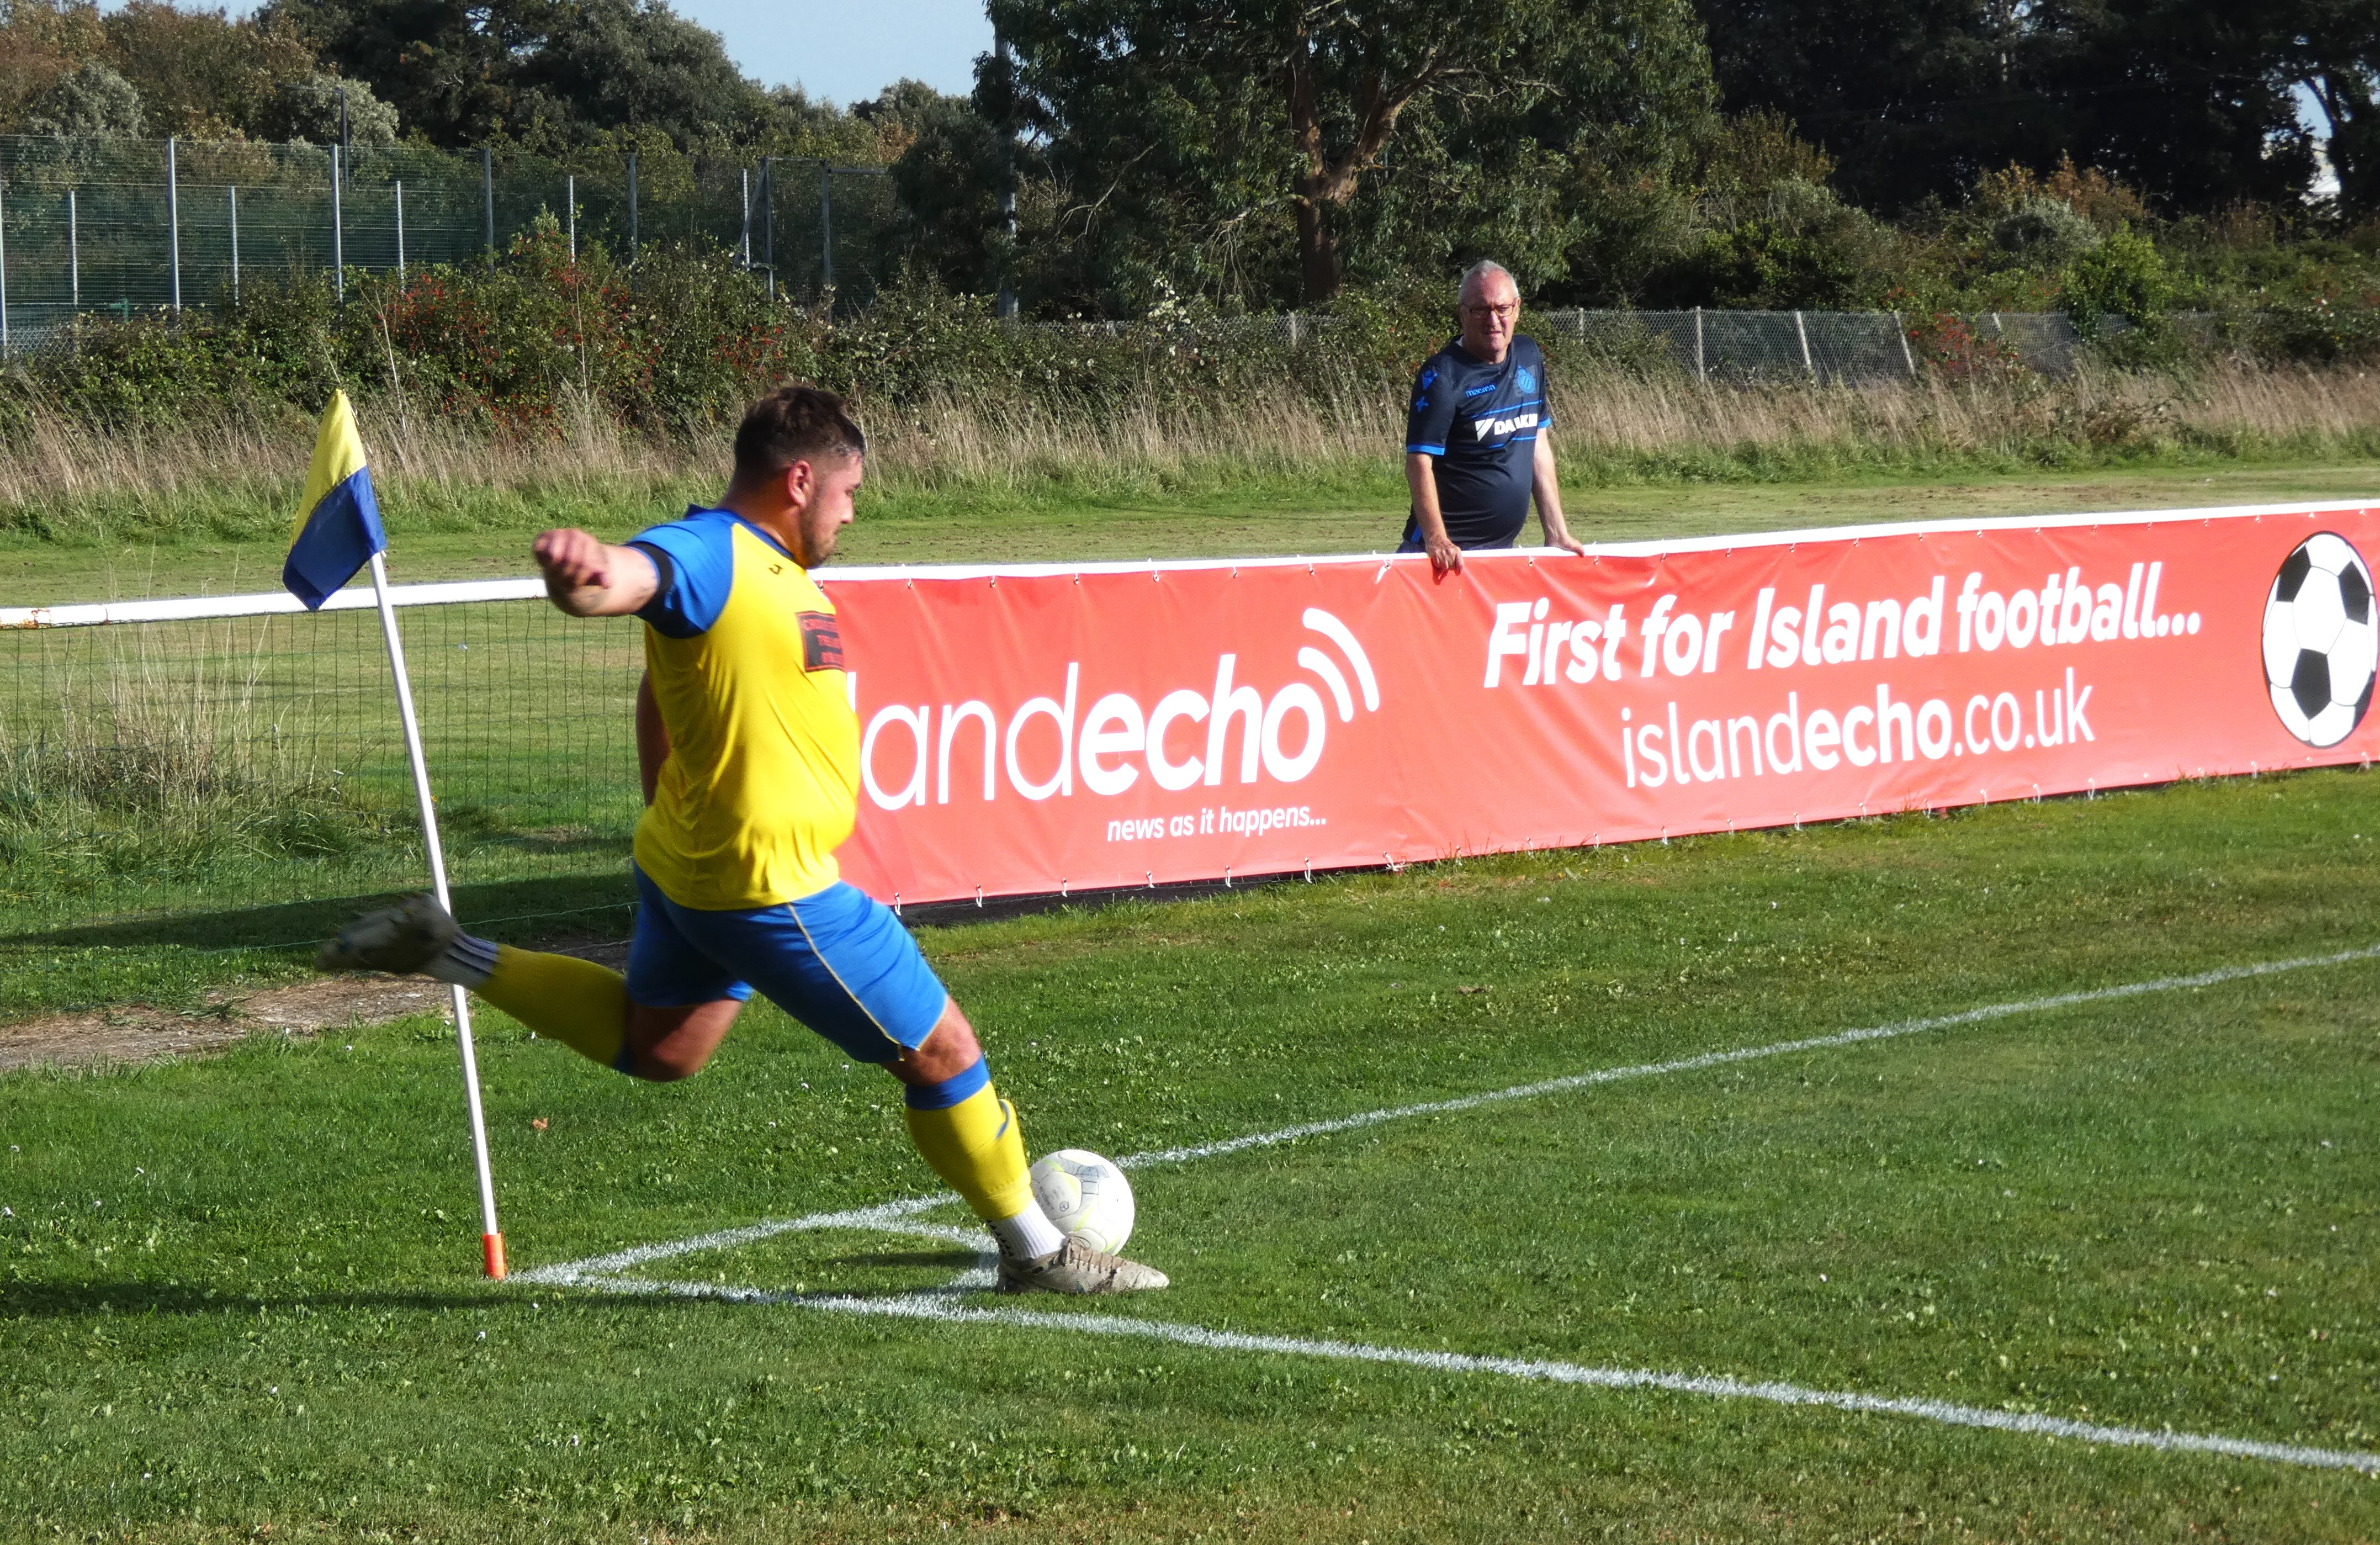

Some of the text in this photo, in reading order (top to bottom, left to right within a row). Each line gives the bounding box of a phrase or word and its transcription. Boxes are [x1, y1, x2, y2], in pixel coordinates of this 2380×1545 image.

[1466, 384, 1496, 398] macron
[1483, 562, 2201, 689] First for Island football...
[846, 653, 1327, 811] andecho
[1621, 666, 2096, 789] islandecho.co.uk
[1107, 806, 1327, 842] news as it happens...
